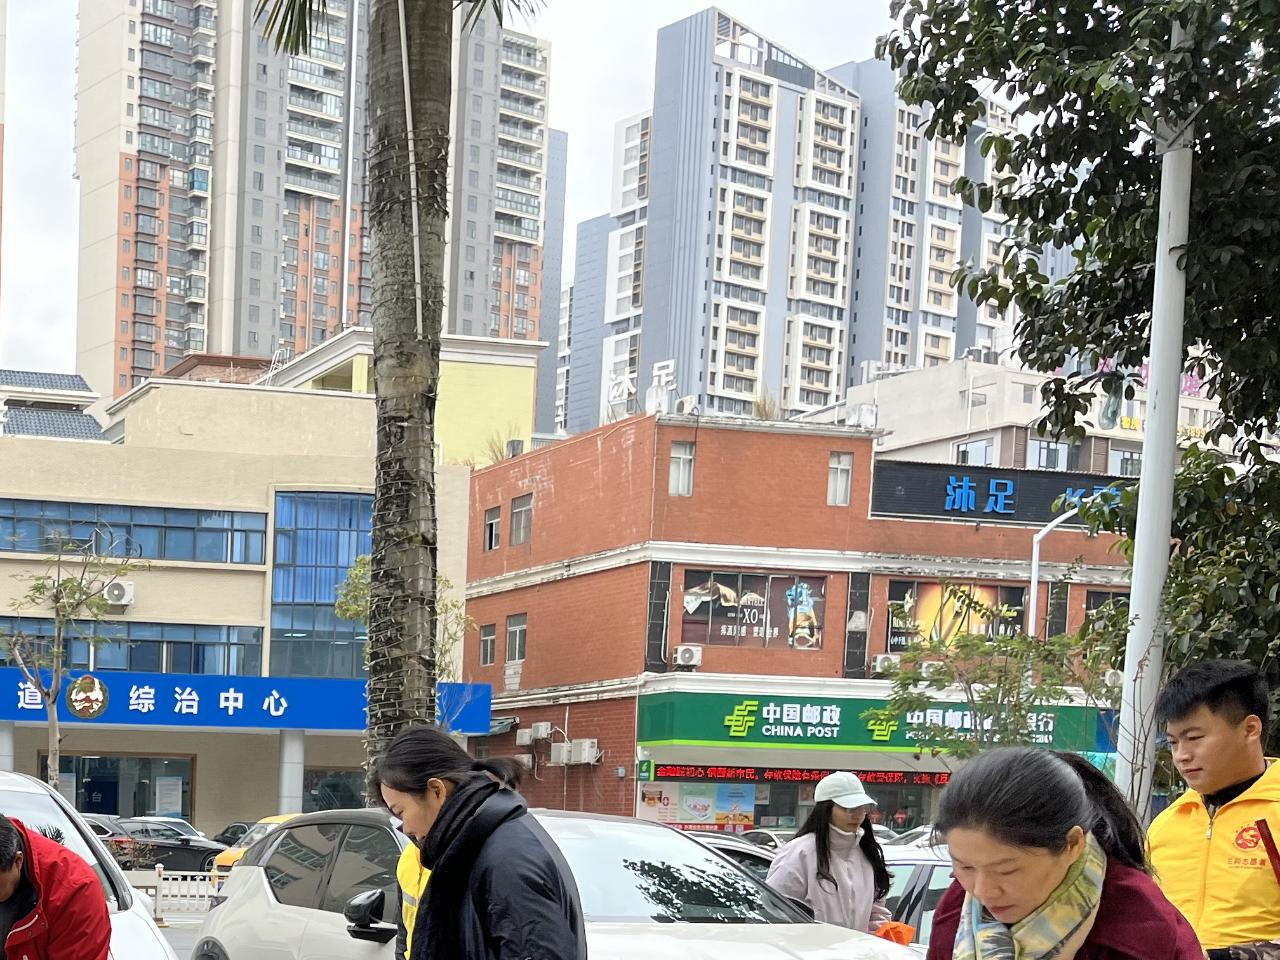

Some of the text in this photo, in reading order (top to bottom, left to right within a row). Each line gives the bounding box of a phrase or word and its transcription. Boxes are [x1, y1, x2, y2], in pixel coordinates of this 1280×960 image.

[743, 609, 759, 624] XO
[128, 685, 288, 717] 综治中心
[762, 702, 841, 725] 中国邮政
[762, 724, 840, 738] CHINA POST
